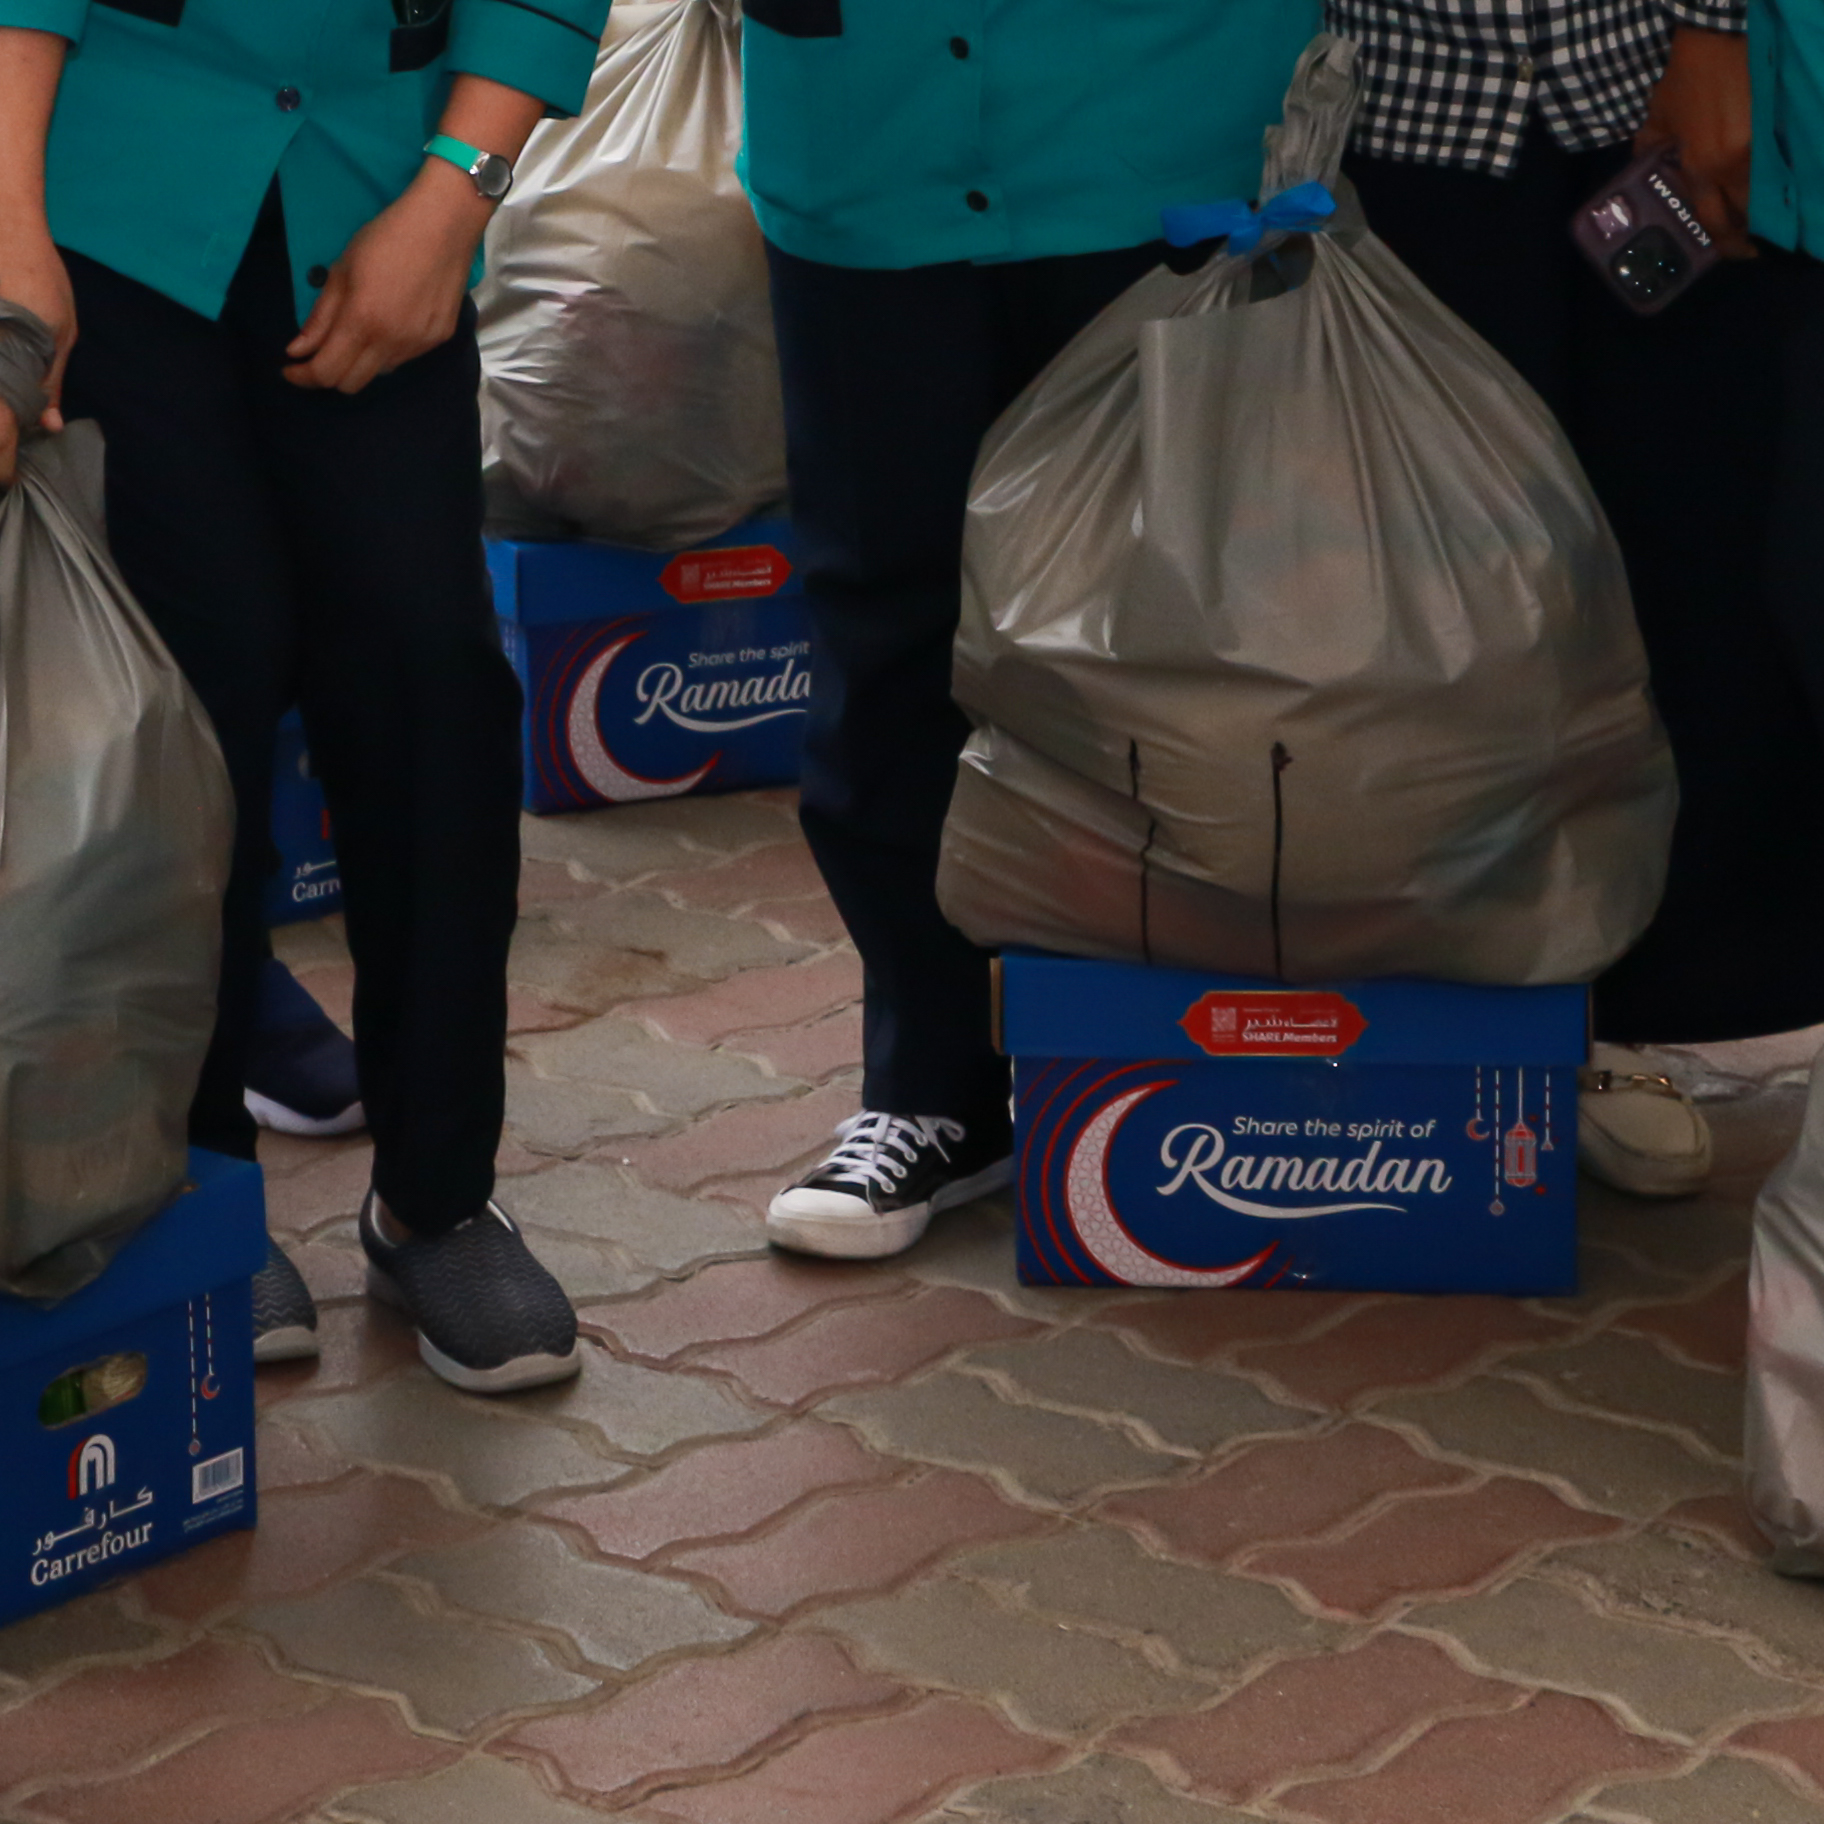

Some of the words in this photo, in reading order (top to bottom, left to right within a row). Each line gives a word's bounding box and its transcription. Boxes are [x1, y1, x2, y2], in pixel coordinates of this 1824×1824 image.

[1649, 173, 1711, 246] KUROMI
[688, 651, 736, 668] Share
[739, 646, 766, 662] the
[770, 641, 810, 661] spirit
[634, 659, 811, 732] Ramada
[1282, 1031, 1338, 1043] Members
[1232, 1116, 1298, 1136] Share
[1305, 1118, 1341, 1137] the
[1347, 1118, 1404, 1142] spirit
[1409, 1119, 1437, 1138] of
[1156, 1123, 1452, 1219] Ramadan
[30, 1522, 153, 1587] Carrefour
